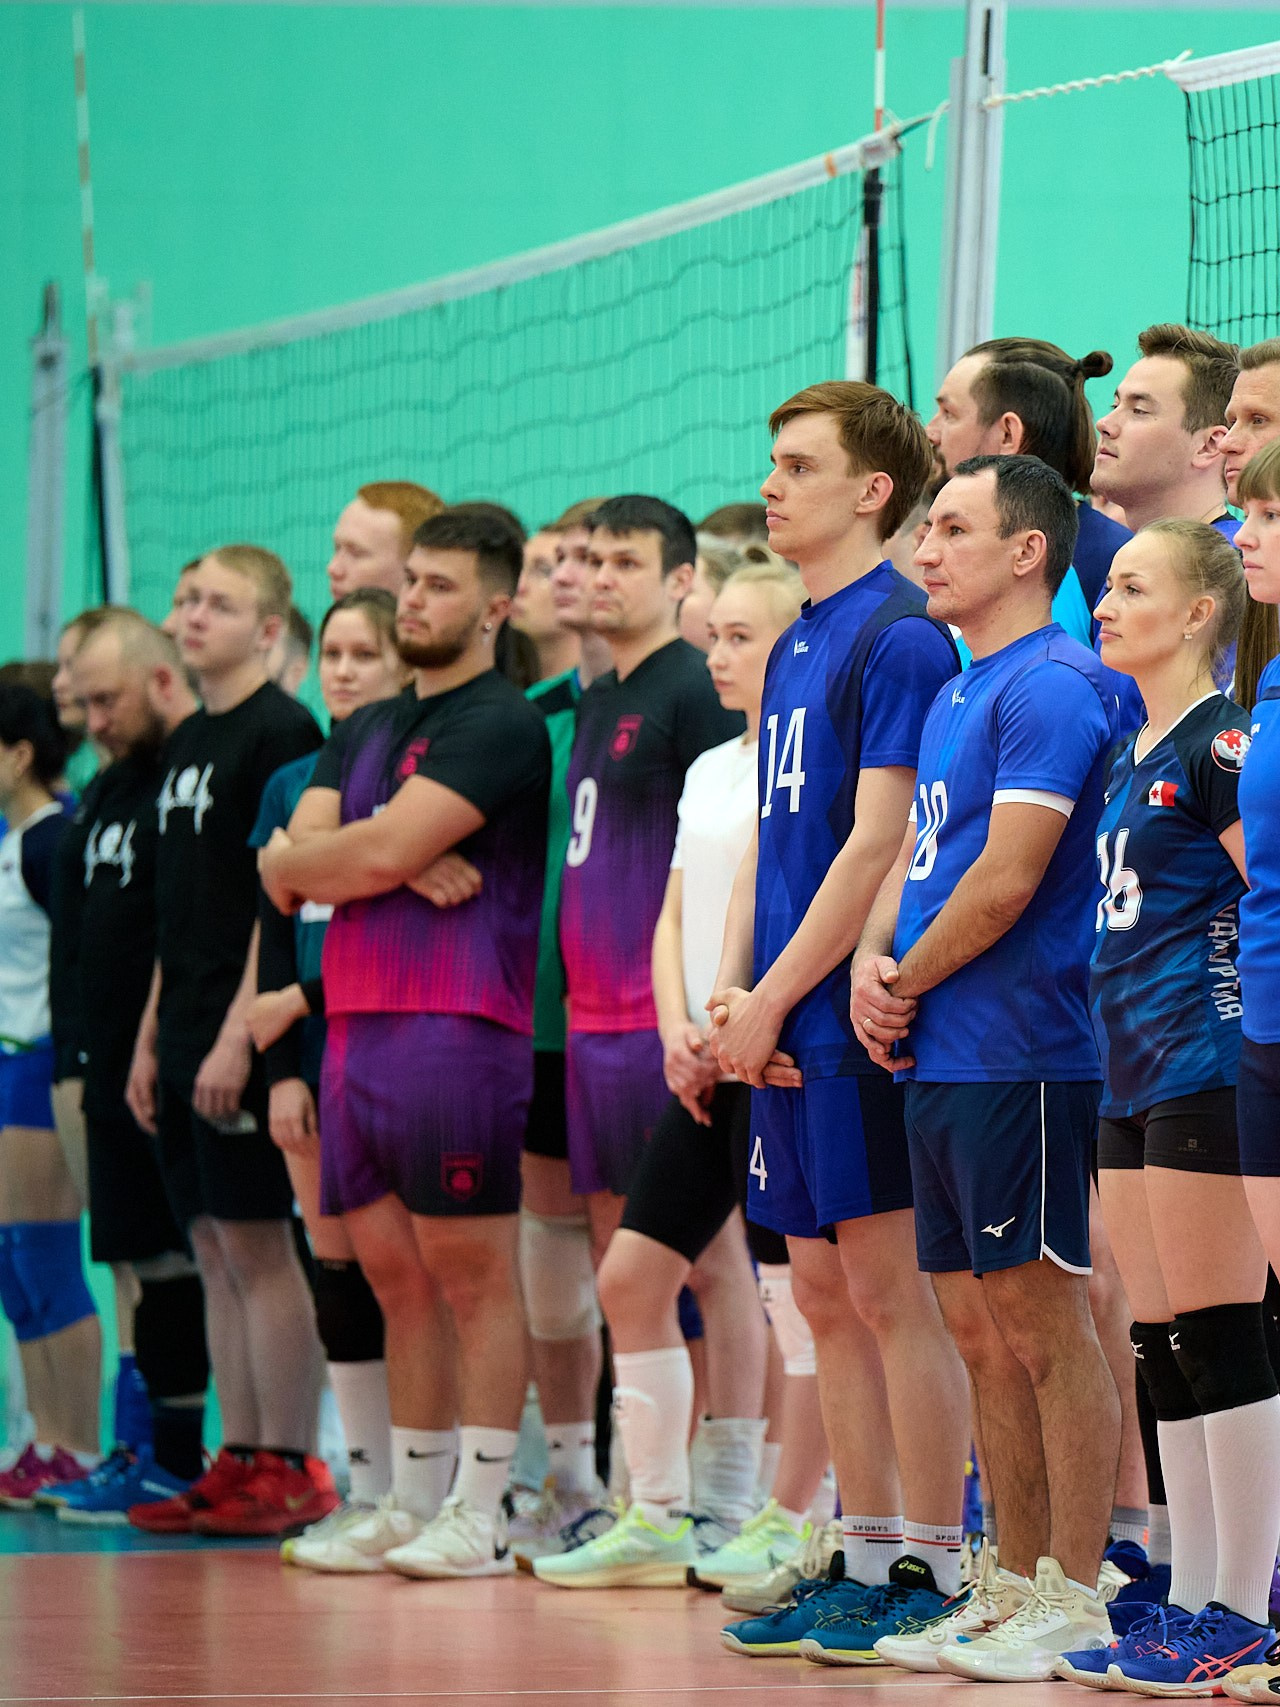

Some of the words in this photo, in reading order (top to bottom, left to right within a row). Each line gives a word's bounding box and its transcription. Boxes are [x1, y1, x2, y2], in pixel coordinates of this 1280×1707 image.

[760, 707, 807, 819] 14
[566, 777, 598, 868] 9
[904, 780, 948, 881] 10
[1096, 828, 1143, 932] 16
[750, 1135, 768, 1191] 4
